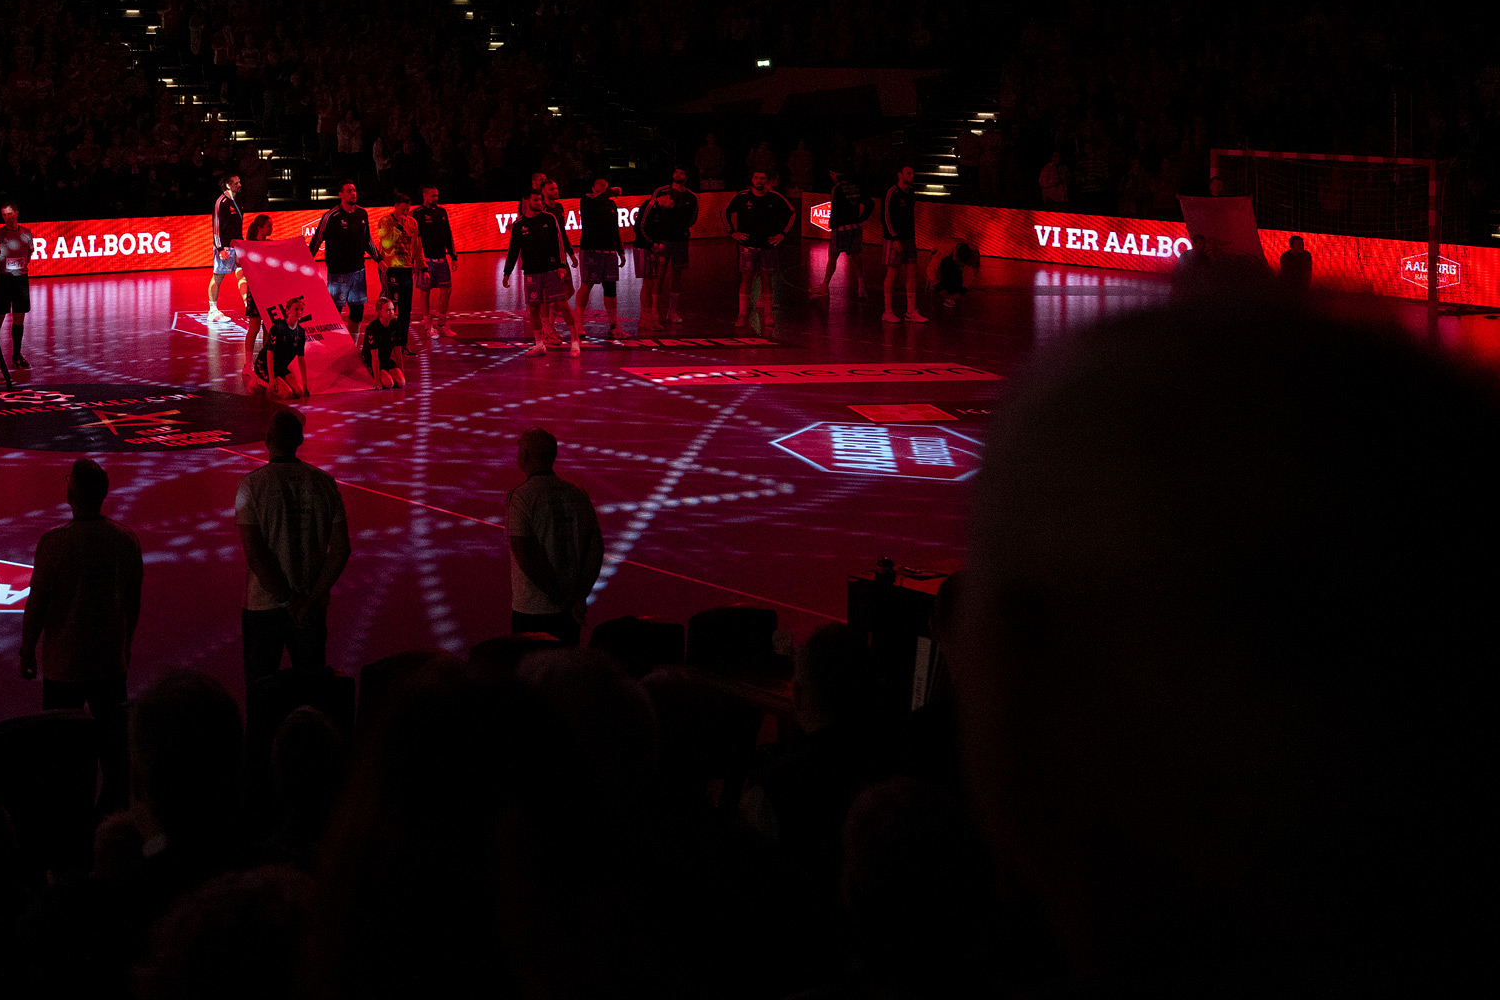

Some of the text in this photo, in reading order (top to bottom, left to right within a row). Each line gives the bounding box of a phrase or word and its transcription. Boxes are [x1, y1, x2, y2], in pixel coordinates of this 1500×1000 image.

[52, 231, 171, 259] AALBORG
[1034, 224, 1193, 258] VI ER AALBO
[830, 425, 900, 472] AALBORG
